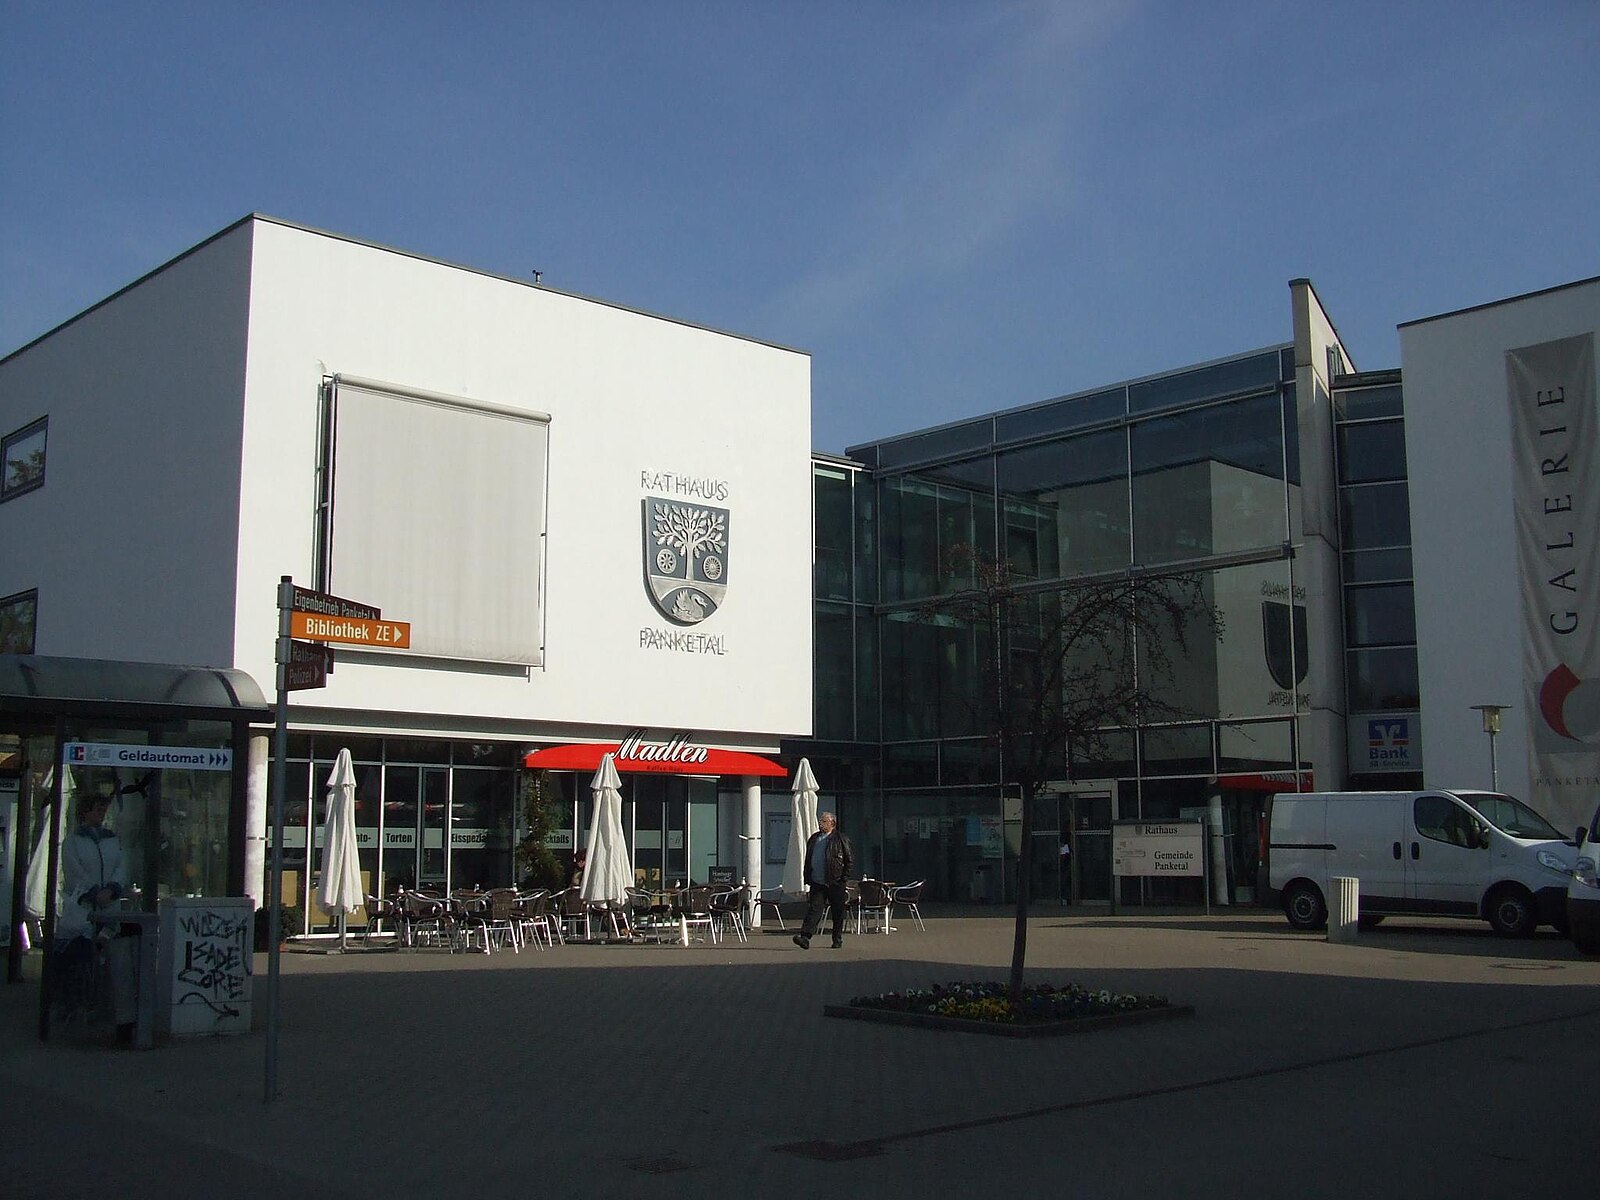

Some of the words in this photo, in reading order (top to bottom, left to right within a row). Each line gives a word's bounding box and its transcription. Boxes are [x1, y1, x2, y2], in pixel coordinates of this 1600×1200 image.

[641, 470, 728, 501] RATHAUS
[1537, 386, 1579, 635] GALERIE
[294, 590, 339, 616] Eigenbetrieb
[306, 618, 369, 640] Bibliothek
[375, 625, 390, 642] ZE
[640, 628, 727, 655] PANKETAL
[611, 729, 708, 763] Madlen
[1369, 747, 1409, 759] Bank
[118, 749, 205, 764] Geldautomat
[386, 832, 412, 843] Torten
[1145, 825, 1178, 835] Rathaus
[1154, 850, 1194, 860] Gemeinde
[1154, 861, 1189, 870] Panketal
